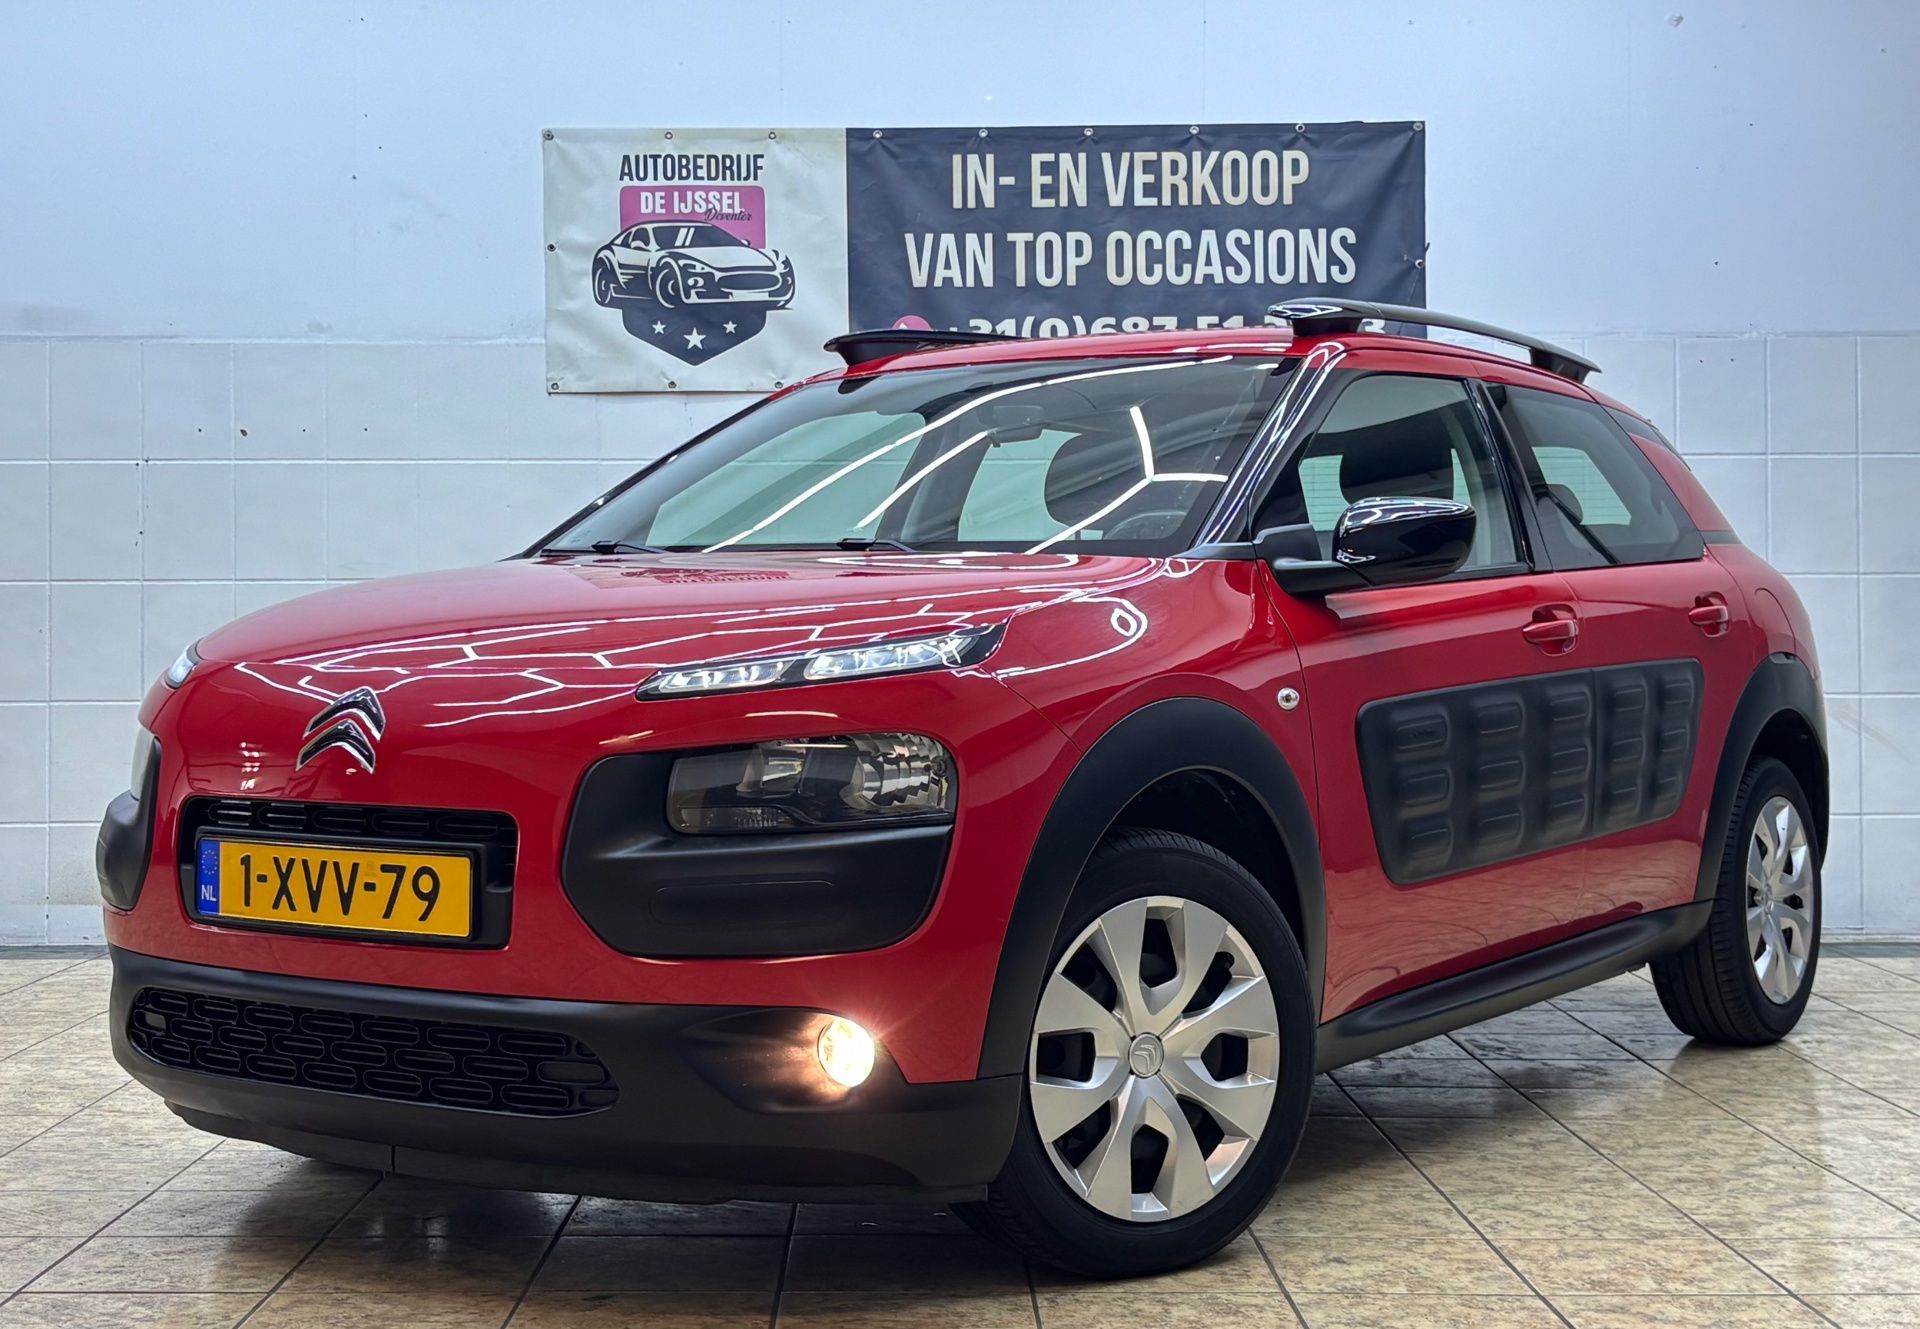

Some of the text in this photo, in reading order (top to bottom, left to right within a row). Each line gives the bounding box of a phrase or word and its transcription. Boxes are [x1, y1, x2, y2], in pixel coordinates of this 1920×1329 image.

[619, 153, 765, 182] AUTOBEDRIJF
[951, 149, 1310, 210] IN- EN VERKOOP
[640, 190, 745, 215] DE IJSSEL
[703, 205, 753, 222] Deventer
[904, 226, 1358, 289] VAN TOP OCCASIONS
[201, 884, 217, 901] NL
[239, 852, 441, 922] 1-XVV-79
